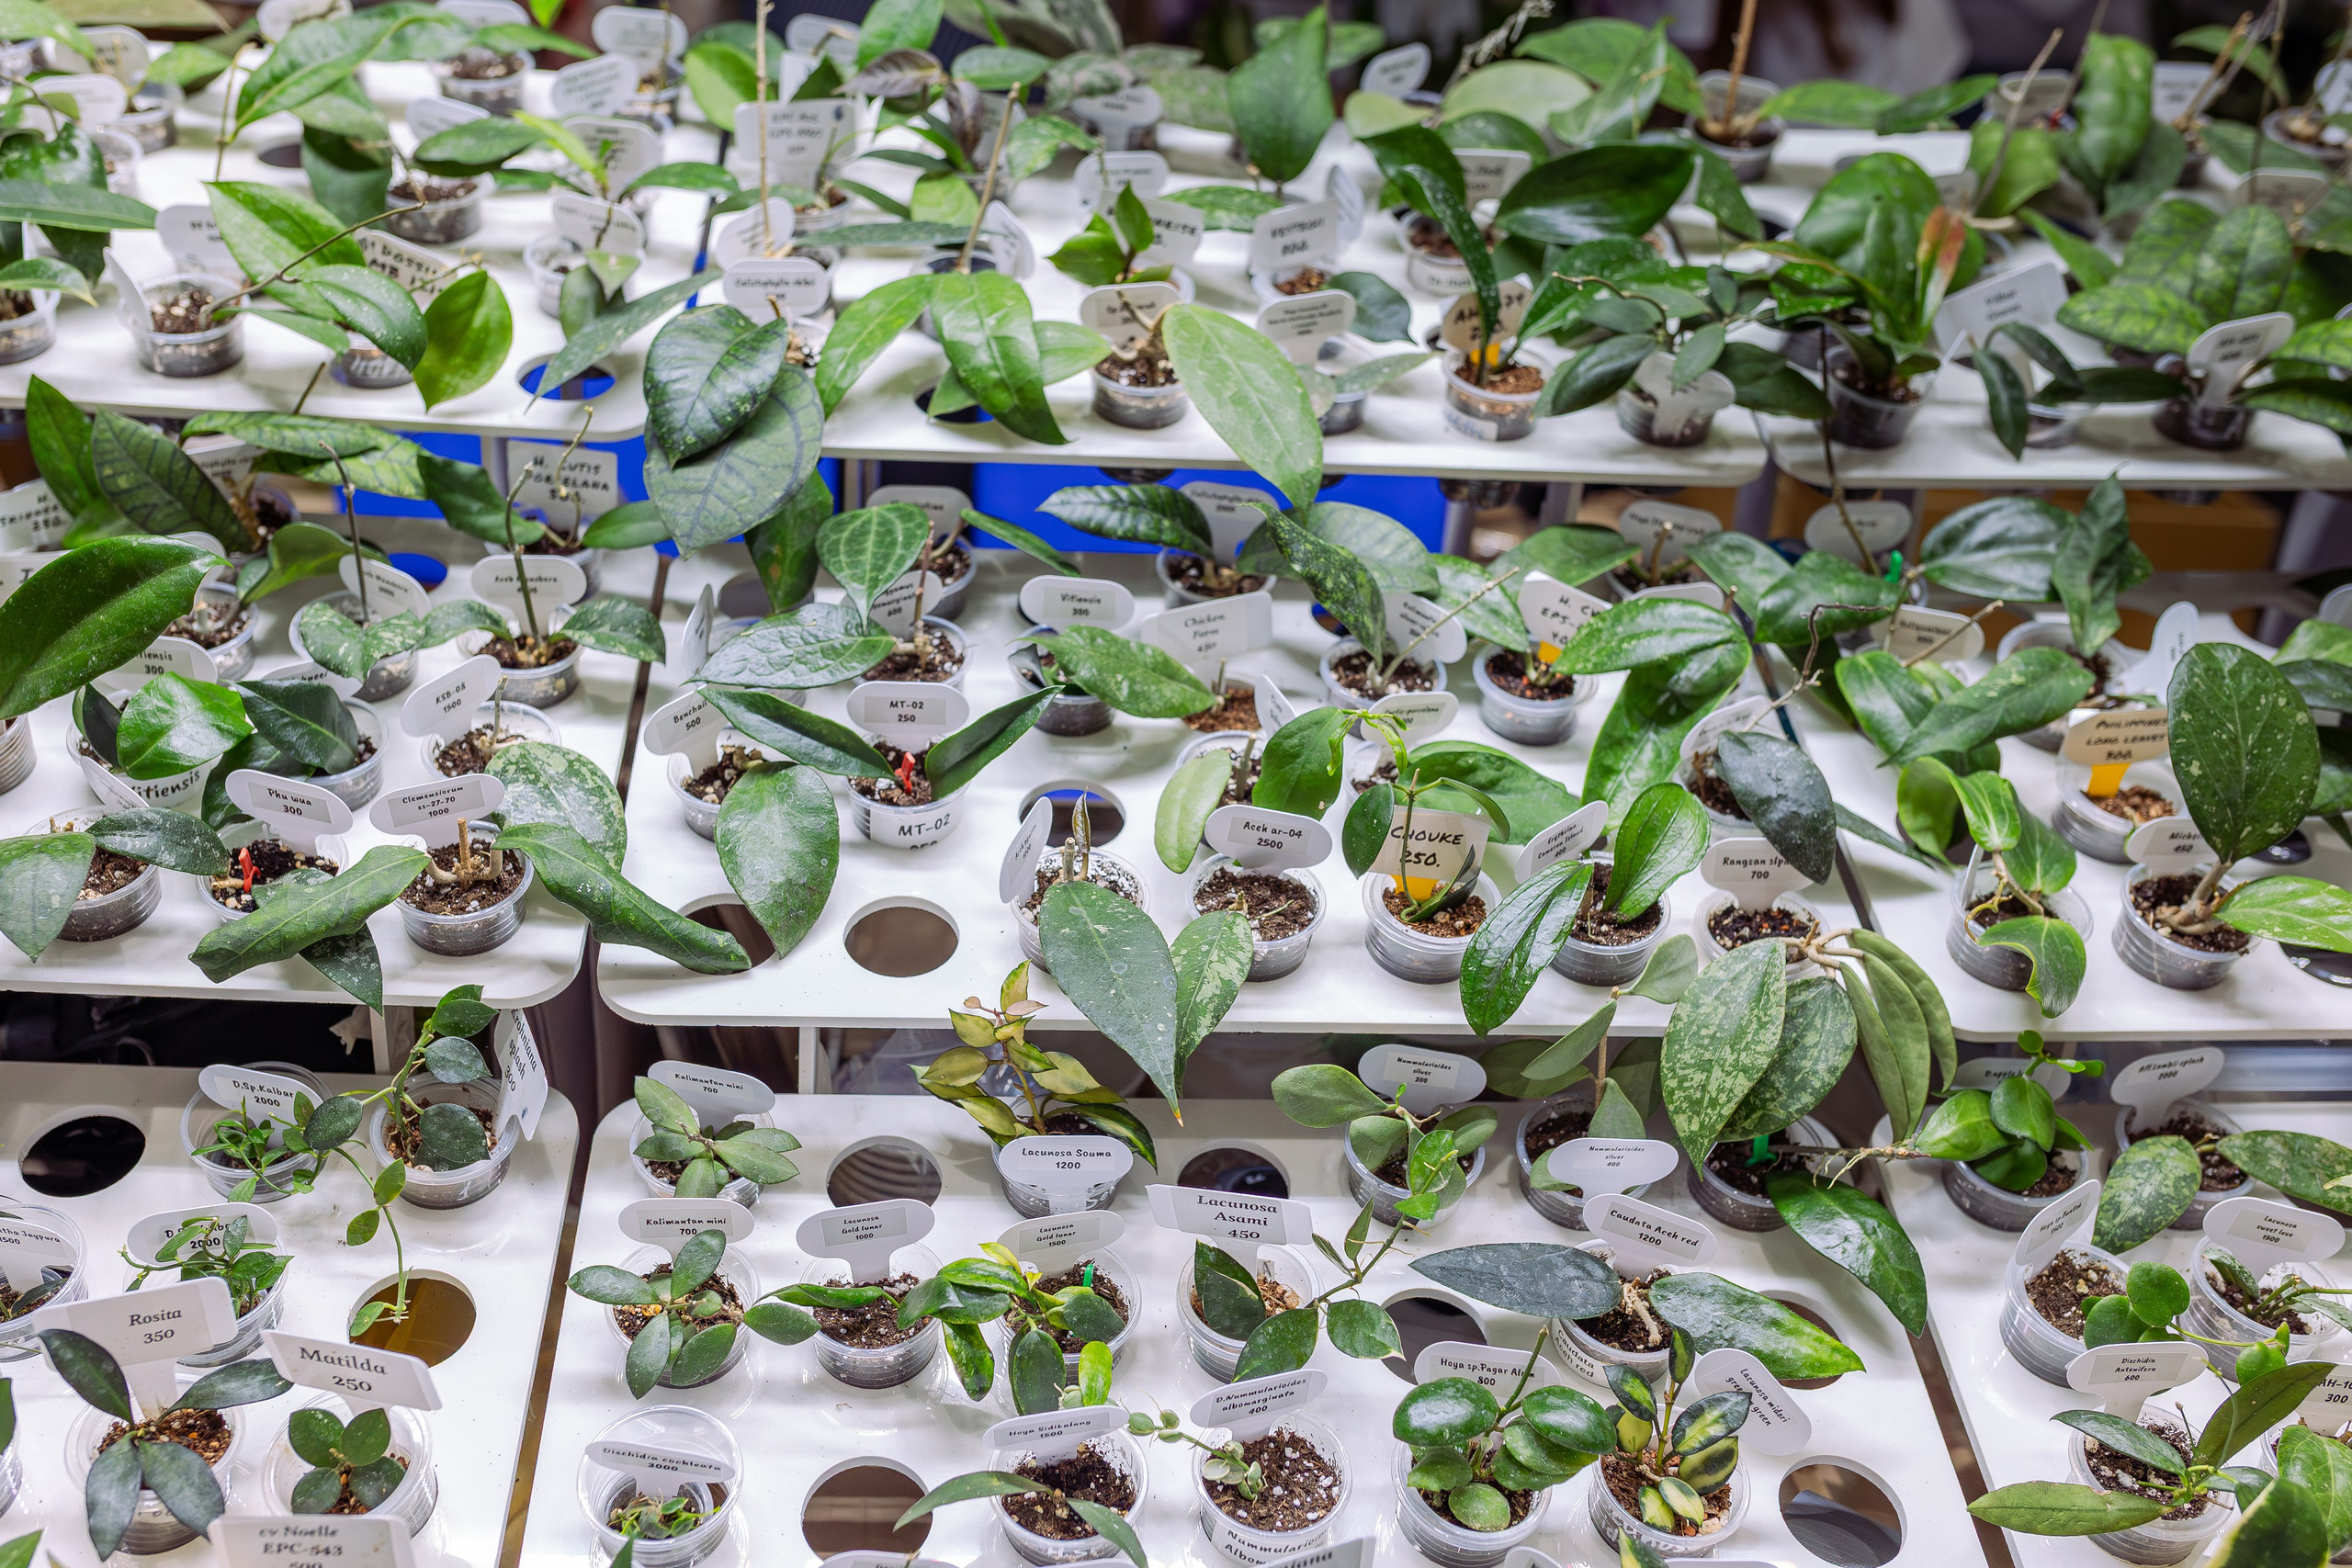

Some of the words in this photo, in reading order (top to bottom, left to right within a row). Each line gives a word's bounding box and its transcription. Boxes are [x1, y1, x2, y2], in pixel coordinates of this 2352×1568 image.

[435, 682, 466, 705] KSB-08
[444, 699, 461, 714] 1500
[889, 701, 924, 710] MT-02
[685, 716, 701, 731] 500
[898, 714, 916, 723] 250
[267, 788, 288, 801] Phu
[283, 804, 303, 816] 300
[428, 807, 449, 818] 1000
[898, 813, 950, 837] MT-02
[1243, 821, 1268, 833] Aceh
[1271, 828, 1303, 839] ar-04
[1257, 837, 1283, 850] 2500
[1750, 871, 1770, 880] 700
[509, 1039, 527, 1079] splash
[1397, 1056, 1452, 1071] Nummularioides
[1413, 1067, 1431, 1076] silver
[504, 1066, 517, 1092] 300
[674, 1072, 724, 1088] Kalimantan
[726, 1082, 743, 1091] mini
[702, 1086, 718, 1095] 700
[254, 1096, 280, 1108] 2000
[1022, 1147, 1072, 1158] Lacunosa
[1075, 1148, 1112, 1158] Souma
[1589, 1145, 1645, 1153] Nummularioides
[1055, 1161, 1081, 1170] 1200
[1196, 1195, 1278, 1213] Lacunosa
[646, 1217, 704, 1227] Kalimantan
[707, 1217, 727, 1225] mini
[843, 1215, 880, 1225] Lacunosa
[1214, 1212, 1268, 1226] Asami
[2264, 1215, 2297, 1229] Lacunosa
[679, 1227, 698, 1236] 700
[842, 1226, 860, 1235] Gold
[861, 1224, 883, 1233] lunar
[1039, 1224, 1074, 1234] Lacunosa
[1227, 1229, 1261, 1240] 450
[1610, 1210, 1652, 1231] Caudata
[1653, 1225, 1679, 1242] Aceh
[1680, 1235, 1699, 1247] red
[21, 1230, 62, 1244] Jaypura
[189, 1237, 220, 1249] 2000
[855, 1233, 874, 1241] 1000
[1036, 1234, 1054, 1243] Gold
[1055, 1231, 1077, 1241] lunar
[1048, 1239, 1067, 1247] 1500
[1638, 1232, 1662, 1247] 1200
[2262, 1235, 2279, 1244] 1500
[129, 1308, 183, 1326] Rosita
[143, 1329, 175, 1344] 350
[1556, 1328, 1595, 1369] Caudata
[299, 1347, 388, 1376] Matilda
[1554, 1336, 1574, 1364] Aceh
[1575, 1363, 1595, 1379] red
[1441, 1358, 1464, 1371] Hoya
[1467, 1363, 1508, 1377] sp.Pagar
[2114, 1366, 2156, 1374] Antenifera
[332, 1375, 372, 1392] 250
[1476, 1376, 1496, 1386] 800
[1222, 1390, 1295, 1412] albomarginata
[1725, 1377, 1744, 1393] gree
[1750, 1406, 1771, 1427] green
[1739, 1368, 1768, 1403] Lacunosa
[1767, 1399, 1791, 1424] midori
[2324, 1393, 2348, 1404] 300
[1249, 1405, 1268, 1416] 400
[1009, 1427, 1035, 1438] Hoya
[1037, 1419, 1092, 1433] Sidikalang
[1039, 1430, 1063, 1439] 1500
[647, 1462, 680, 1472] 3000
